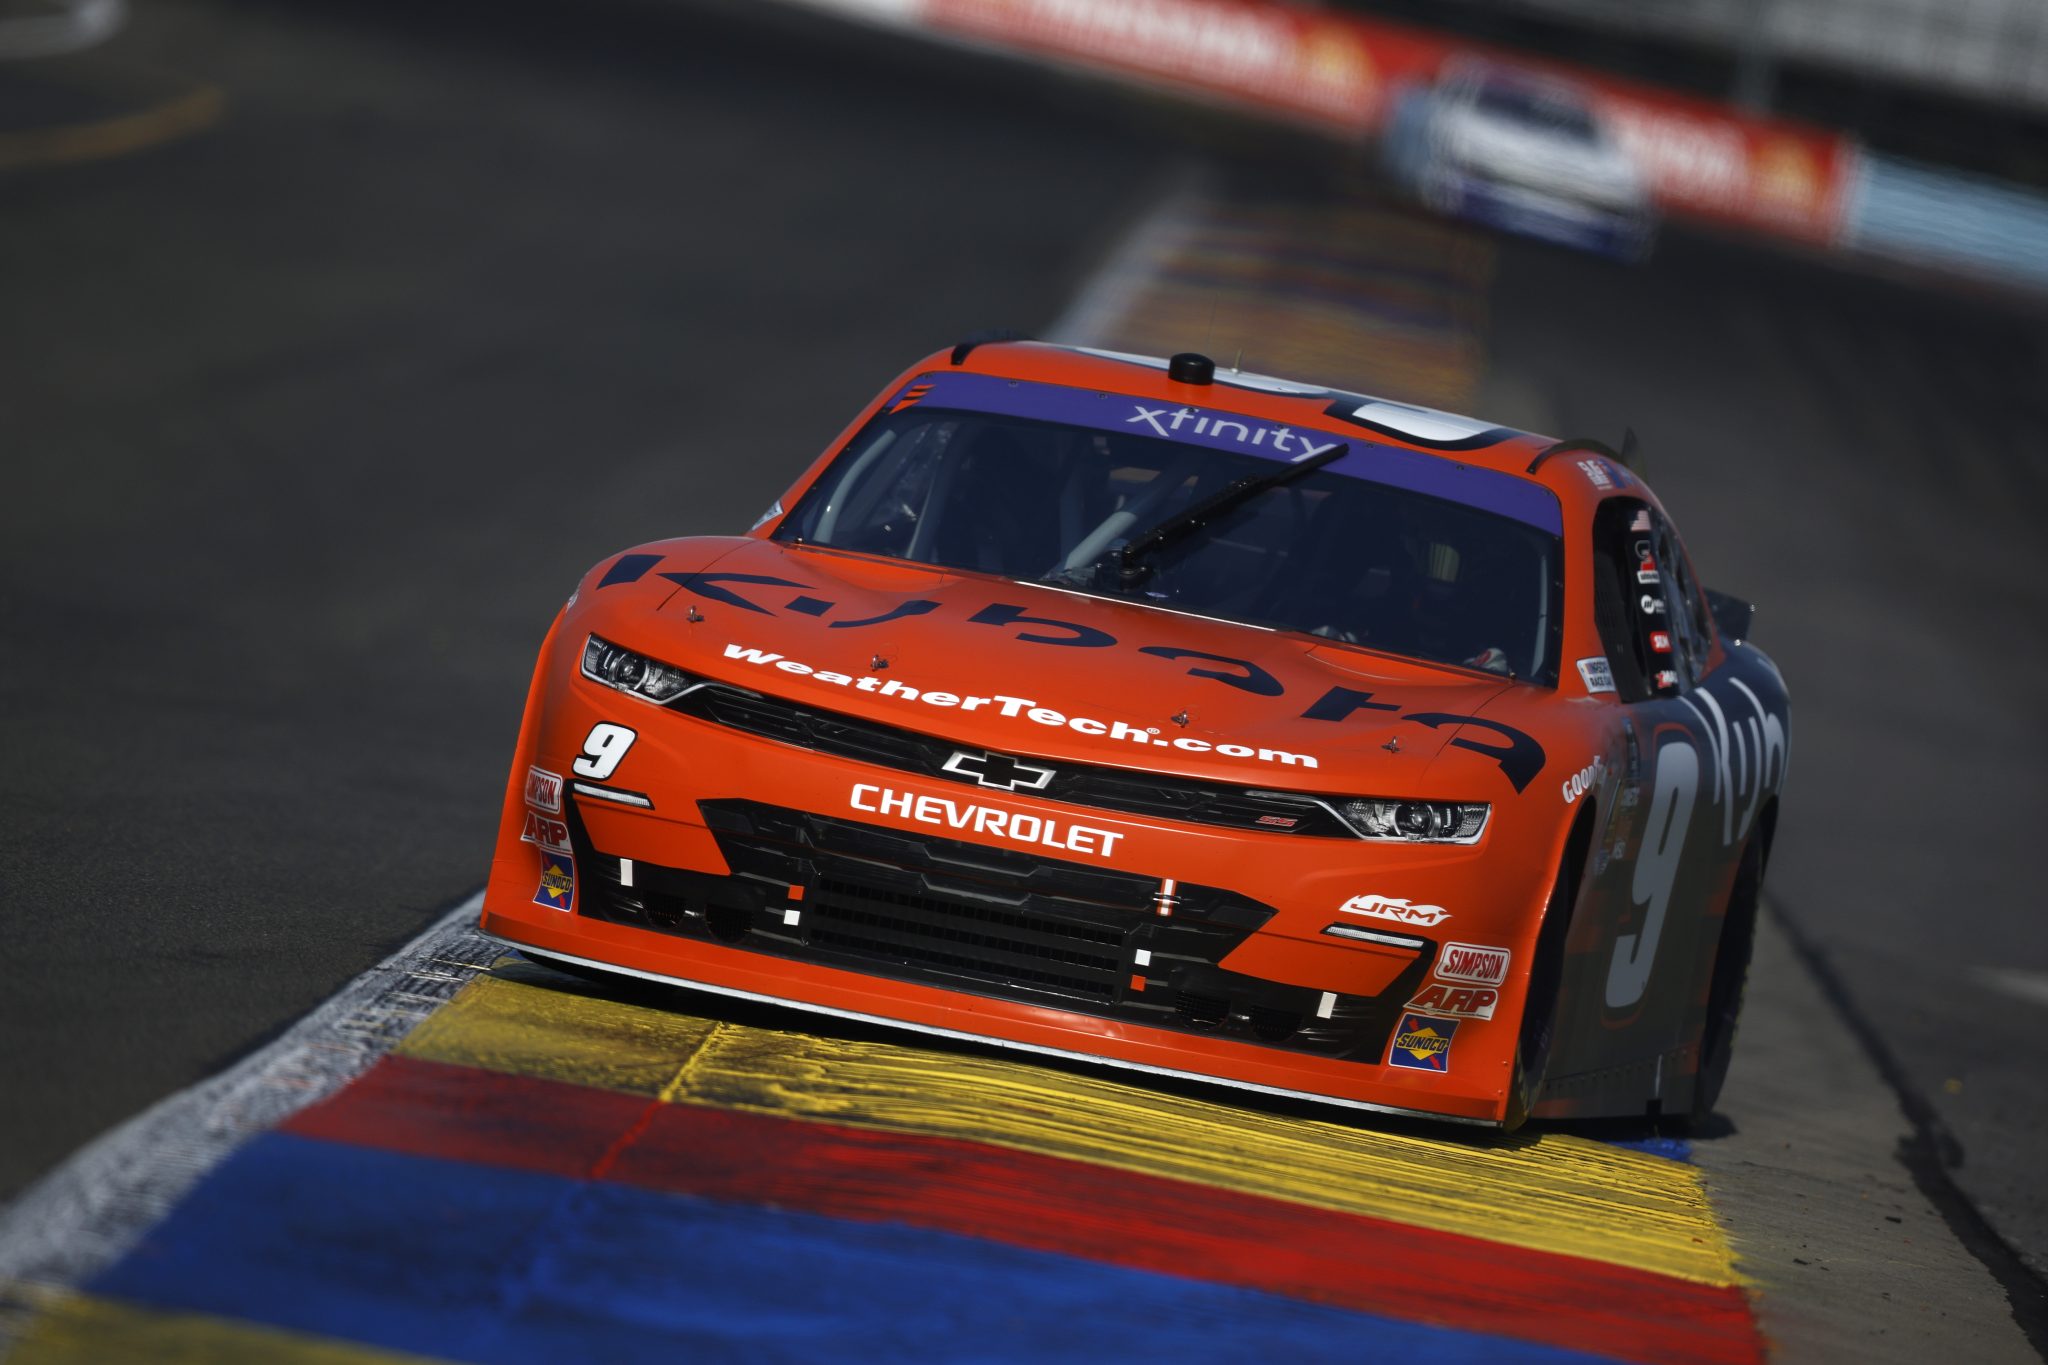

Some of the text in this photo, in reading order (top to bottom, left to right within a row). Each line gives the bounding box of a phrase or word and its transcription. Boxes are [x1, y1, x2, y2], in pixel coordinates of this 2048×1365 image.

[1126, 405, 1337, 463] xfinity
[723, 643, 1318, 769] WeatherTech.com
[573, 723, 636, 779] 9
[525, 813, 568, 847] ARP
[850, 783, 1125, 857] CHEVROLET
[542, 871, 572, 892] SUNOCO
[1605, 740, 1699, 1008] 9
[1350, 902, 1437, 924] JRM
[1443, 949, 1505, 980] SIMPSON
[1413, 986, 1496, 1013] ARP
[1397, 1034, 1449, 1052] SUNOCO
